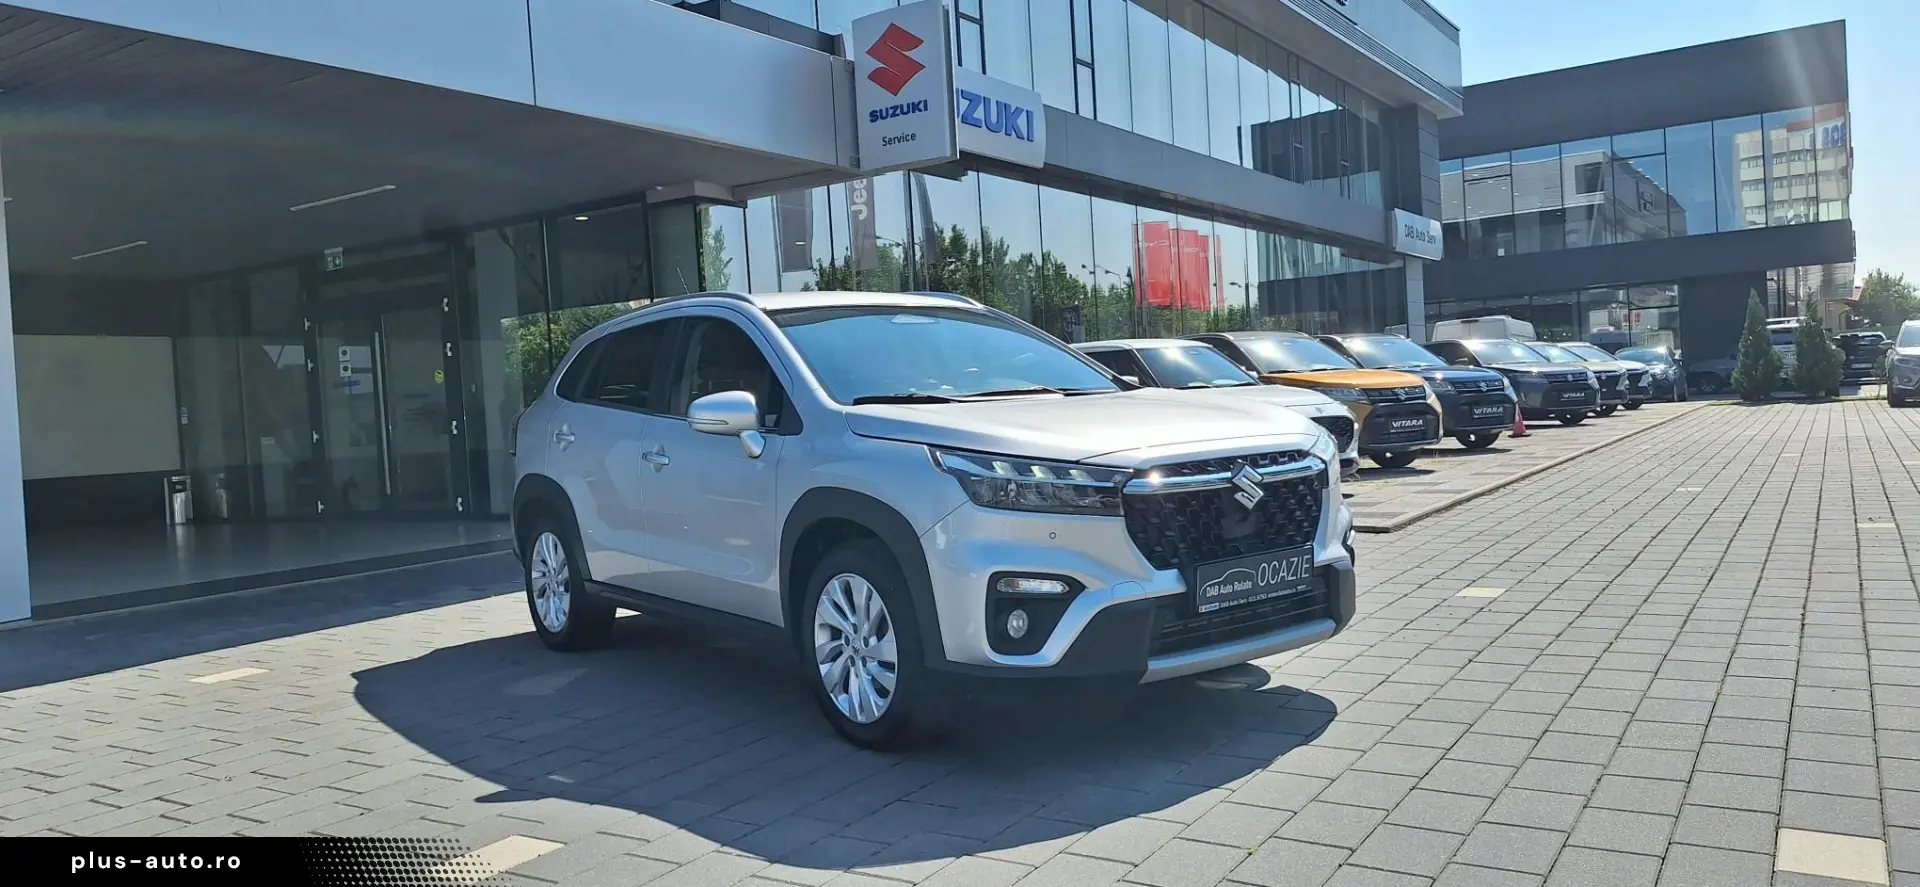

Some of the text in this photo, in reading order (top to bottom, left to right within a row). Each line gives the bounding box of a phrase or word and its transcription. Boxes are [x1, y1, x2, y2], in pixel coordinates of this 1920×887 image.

[869, 99, 928, 123] SUZUKI
[955, 87, 1035, 142] ZUKI
[882, 132, 917, 147] Service
[1415, 228, 1426, 242] Auto
[1426, 230, 1437, 245] Serv
[1473, 406, 1504, 414] VITARA
[1391, 419, 1423, 428] VITARA
[1257, 555, 1312, 587] OCAZIE
[1206, 580, 1253, 597] DAB Auto Rulate
